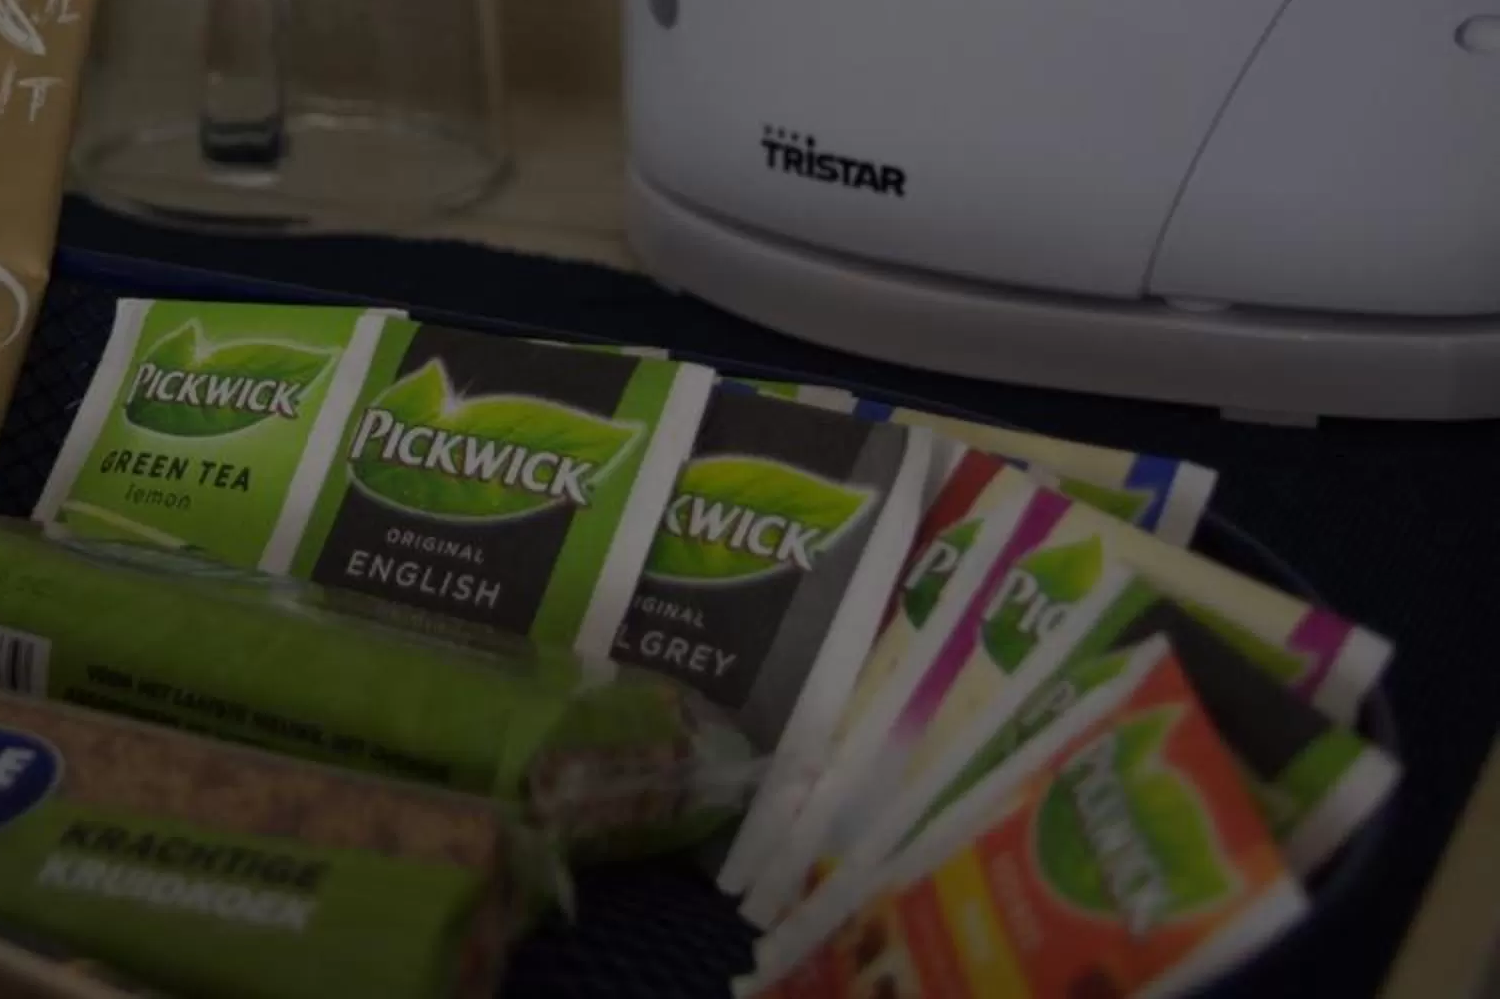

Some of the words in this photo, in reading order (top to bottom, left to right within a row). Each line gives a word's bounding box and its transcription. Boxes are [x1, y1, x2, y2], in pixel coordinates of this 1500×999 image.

[760, 135, 905, 198] TRISTAR
[125, 361, 300, 418] PICKWICK
[100, 449, 189, 481] GREEN
[199, 460, 252, 492] TEA
[350, 407, 593, 506] PICKWICK
[124, 483, 191, 509] lemon
[386, 527, 485, 566] ORIGINAL
[345, 549, 501, 610] ENGLISH
[639, 629, 738, 678] GREY
[58, 820, 329, 890] KRACHTIGE
